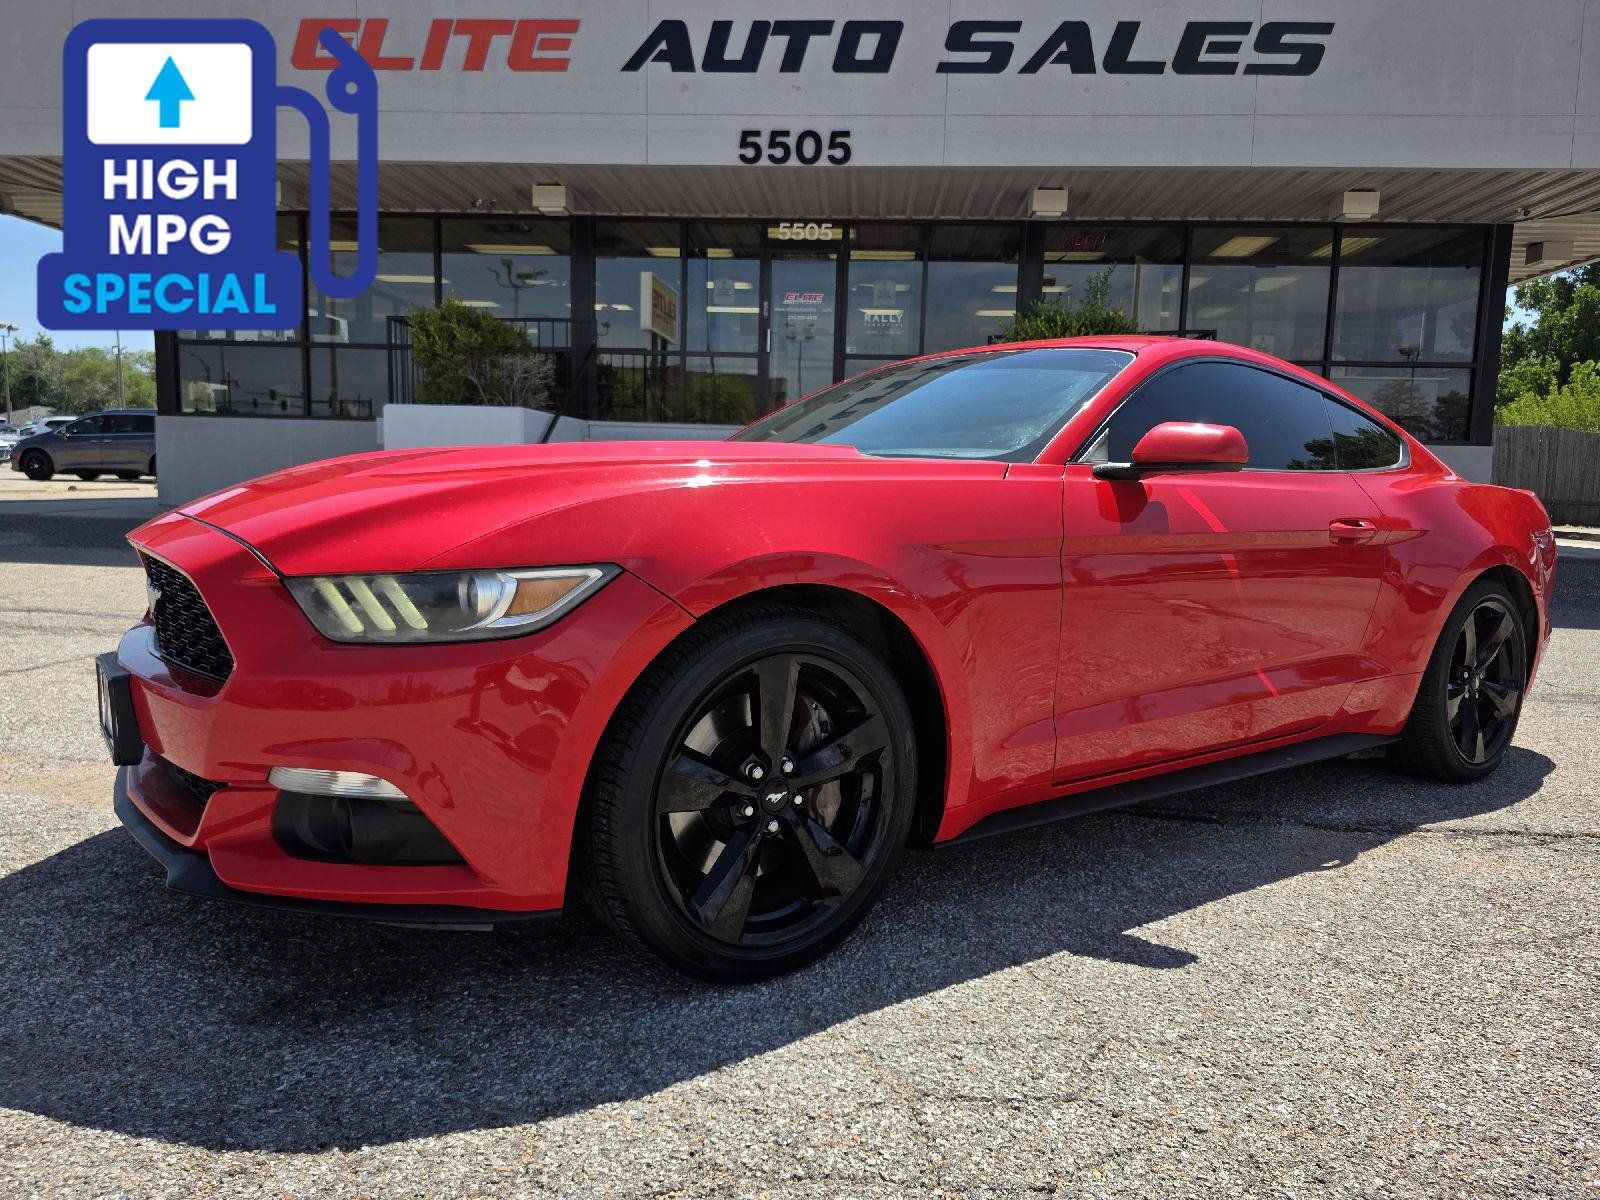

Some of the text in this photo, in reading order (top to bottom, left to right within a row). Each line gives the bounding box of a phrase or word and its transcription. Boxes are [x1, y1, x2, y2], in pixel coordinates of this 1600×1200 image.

[291, 18, 1335, 77] ELITE AUTO SALES
[738, 130, 852, 165] 5505
[779, 222, 833, 241] 5505
[864, 312, 903, 323] RALLY
